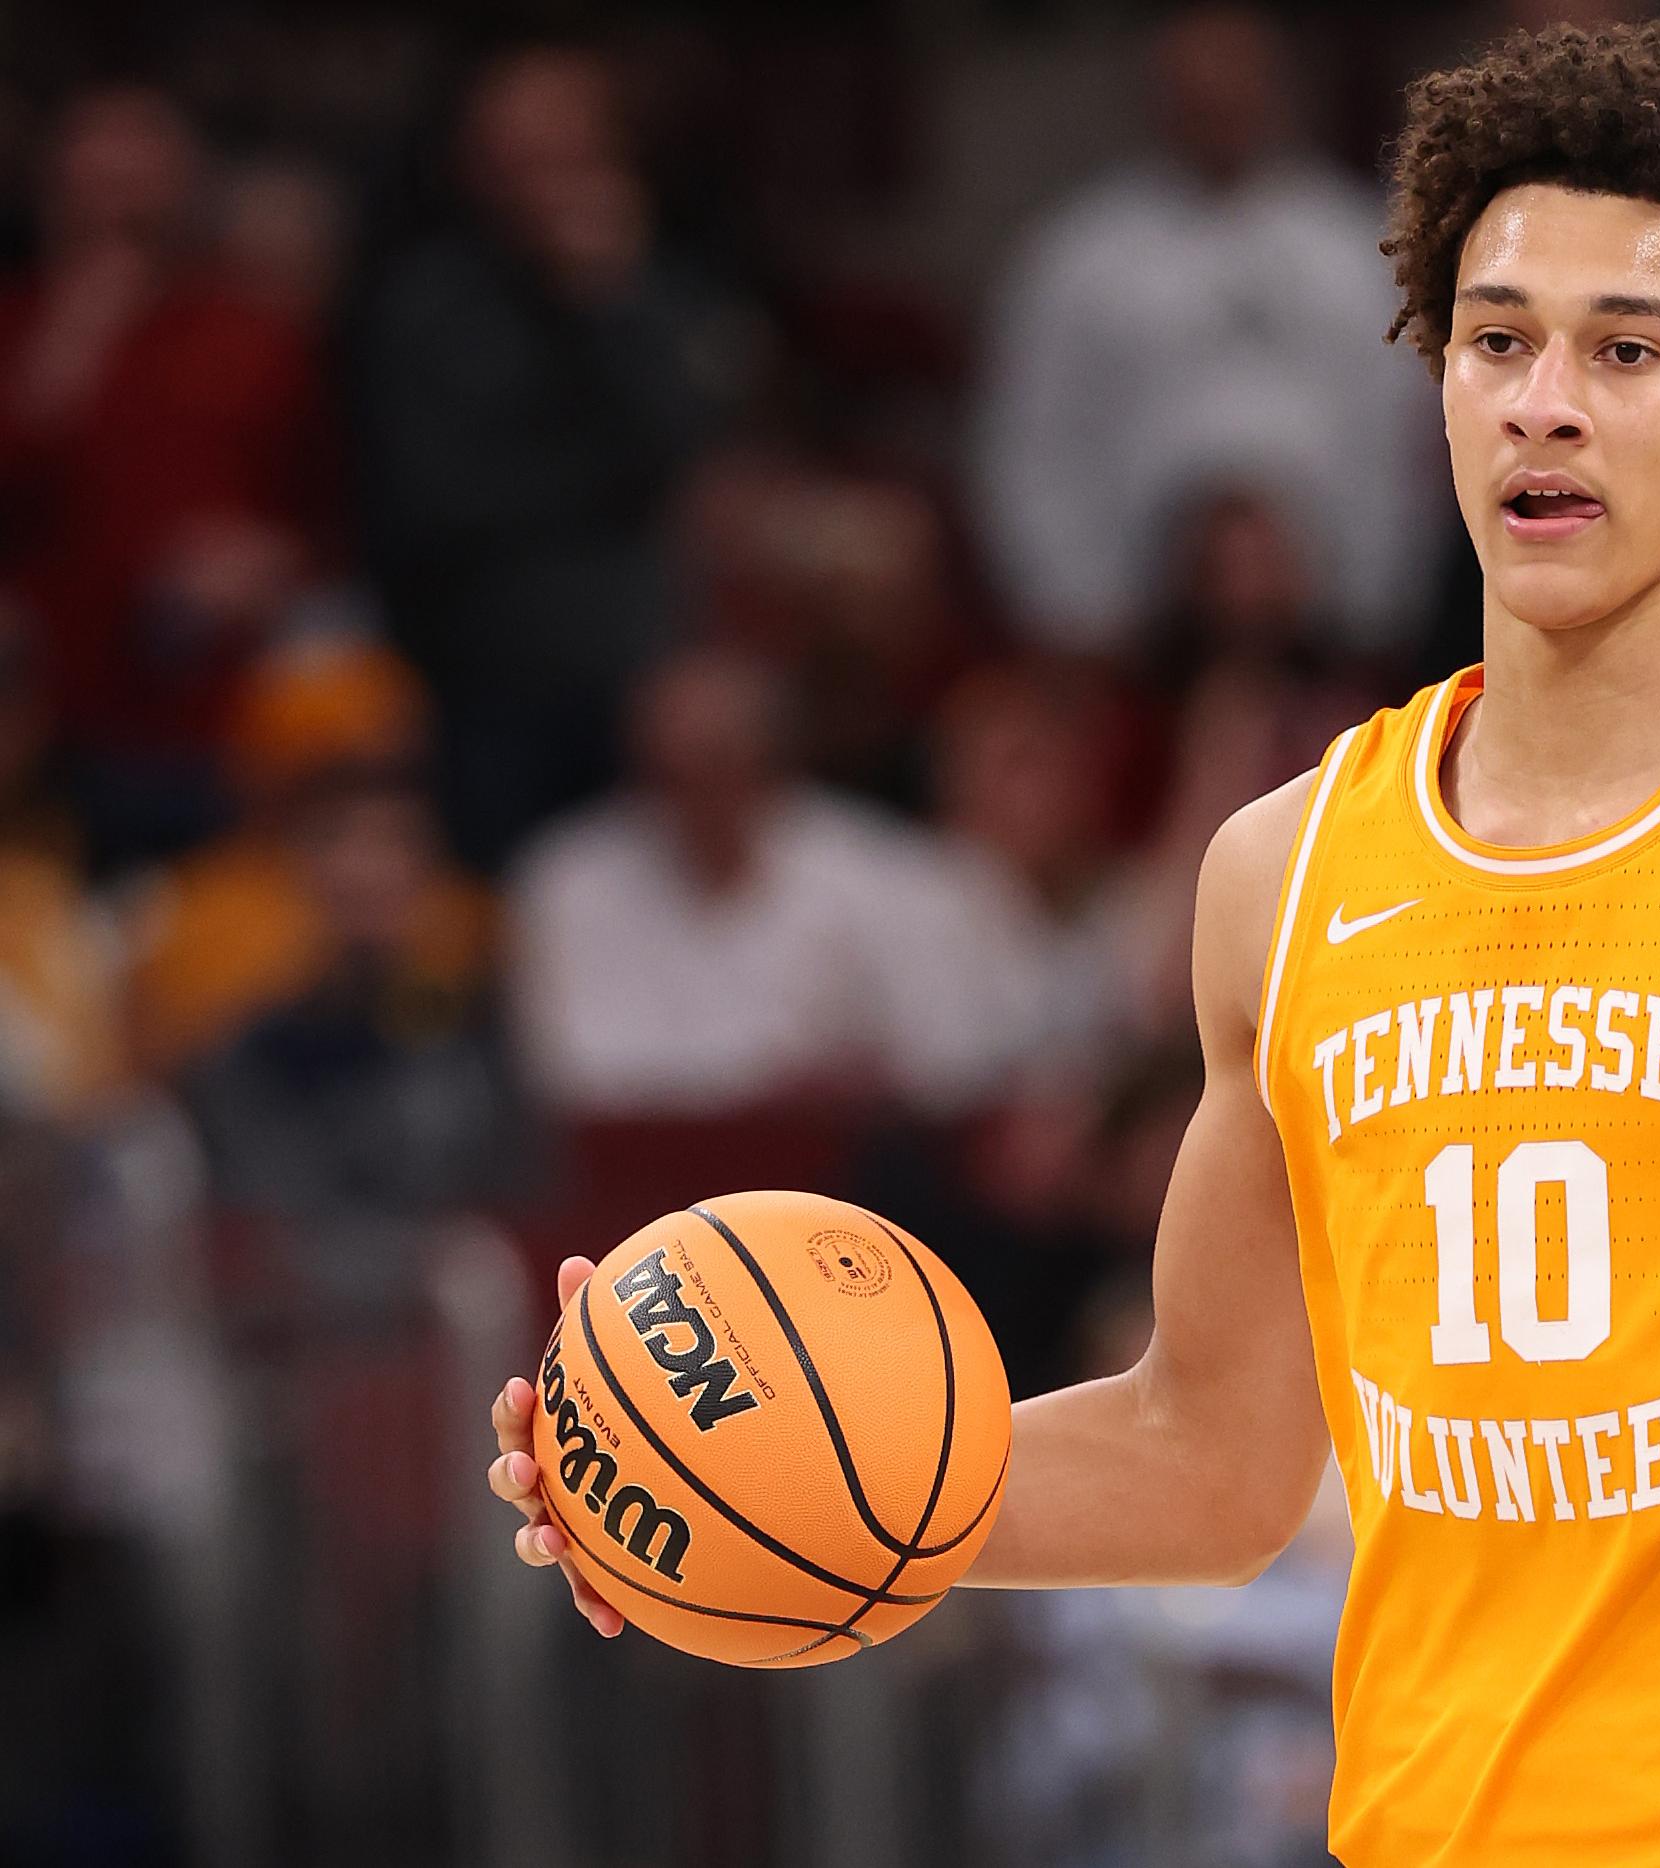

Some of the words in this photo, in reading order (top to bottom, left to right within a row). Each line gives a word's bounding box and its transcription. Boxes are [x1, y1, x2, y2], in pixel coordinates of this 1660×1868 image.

[673, 1239, 695, 1272] BALL
[1424, 1140, 1612, 1366] 10
[690, 1272, 722, 1319] GAME
[613, 1247, 760, 1432] NCAA
[723, 1319, 776, 1401] OFFICIAL
[573, 1377, 594, 1412] NXT
[593, 1412, 622, 1450] EVO
